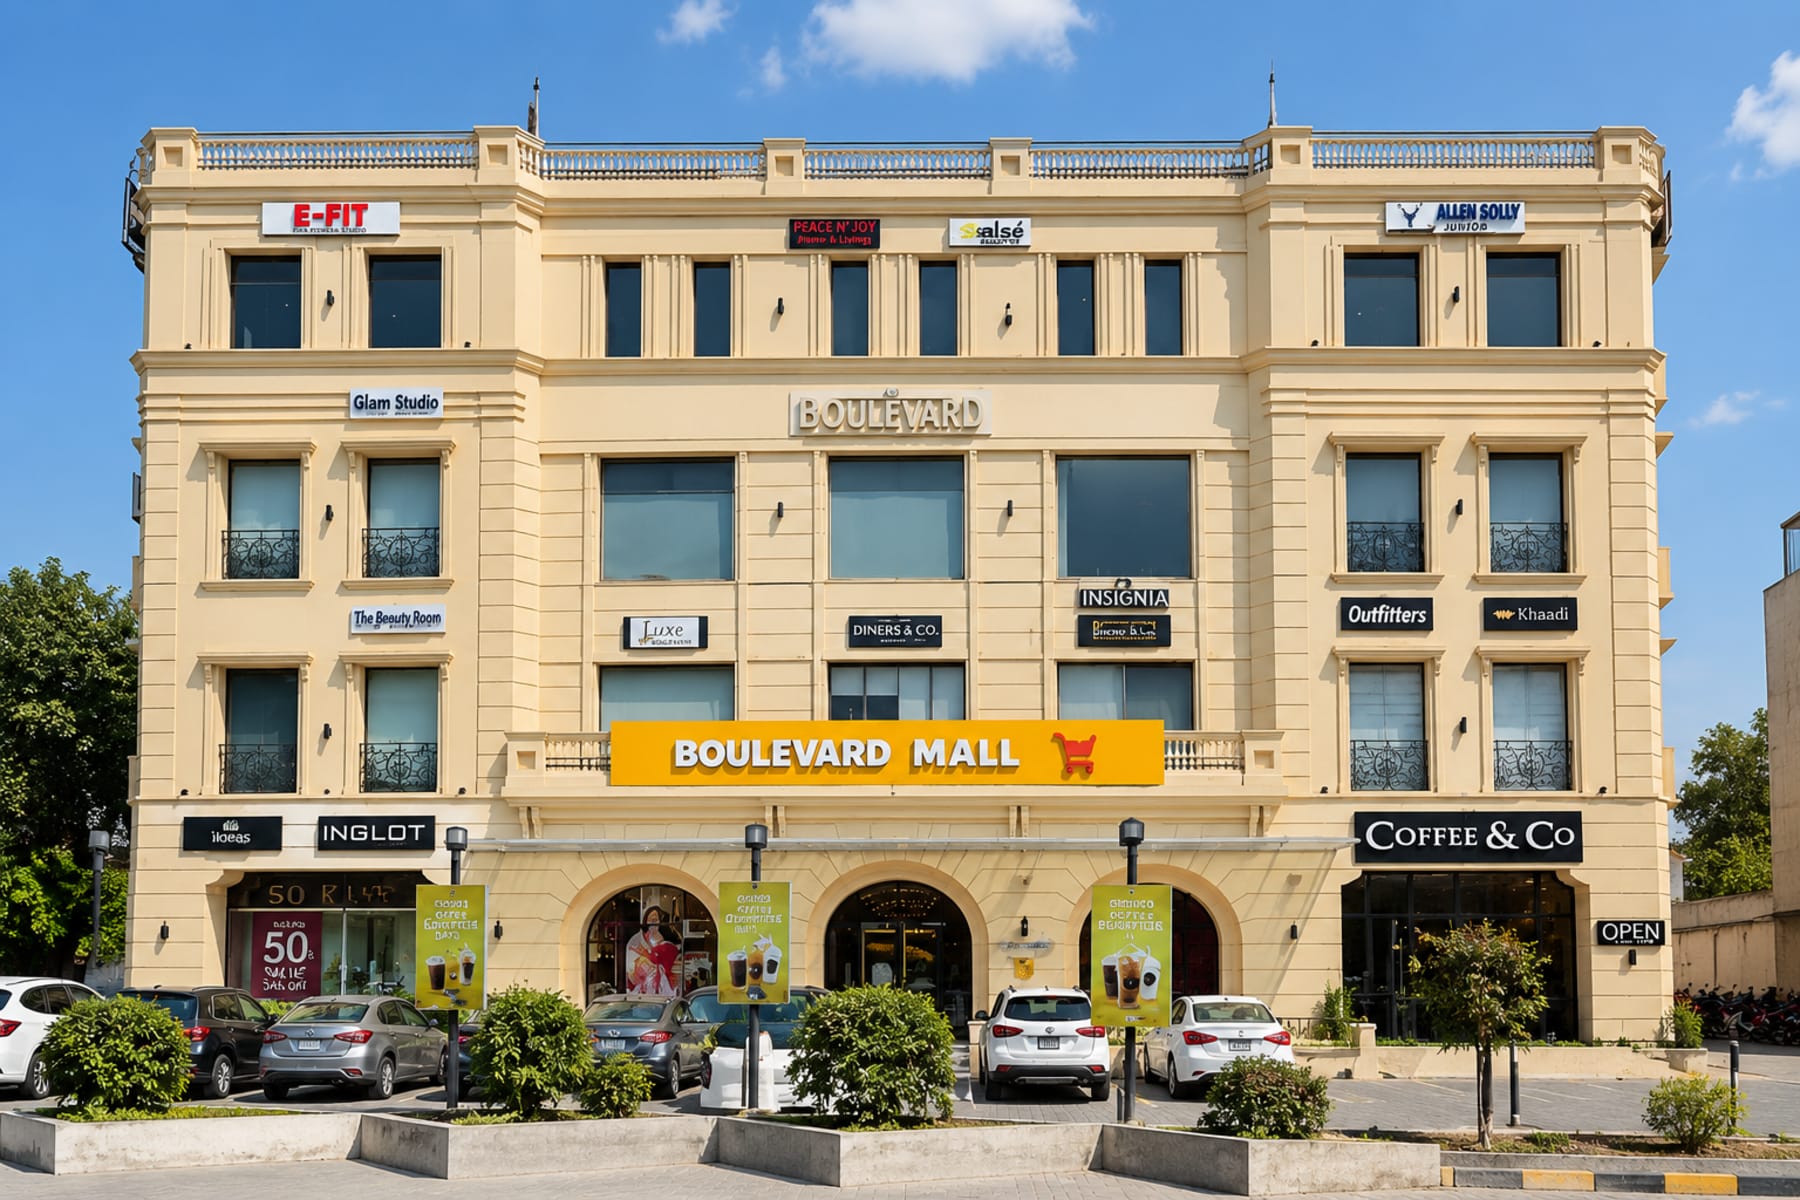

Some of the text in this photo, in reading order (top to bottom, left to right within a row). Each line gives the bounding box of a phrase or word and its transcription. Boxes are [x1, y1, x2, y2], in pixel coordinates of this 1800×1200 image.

[293, 204, 368, 227] E-FIT
[1436, 203, 1521, 221] ALLEN SOLLY
[793, 221, 833, 233] PEACE
[851, 221, 876, 233] JOY
[353, 393, 439, 410] Glam Studio
[799, 398, 983, 429] BOULEVARD
[1082, 589, 1169, 607] INSIGNIA
[353, 610, 374, 624] The
[413, 610, 442, 624] Room
[1348, 604, 1427, 623] Outfitters
[1517, 606, 1569, 621] Khaadi
[853, 624, 939, 636] DINERS & CO.
[674, 739, 1020, 768] BOULEVARD MALL
[323, 824, 426, 841] INGLOT
[1486, 820, 1520, 850] &
[1602, 922, 1660, 941] OPEN
